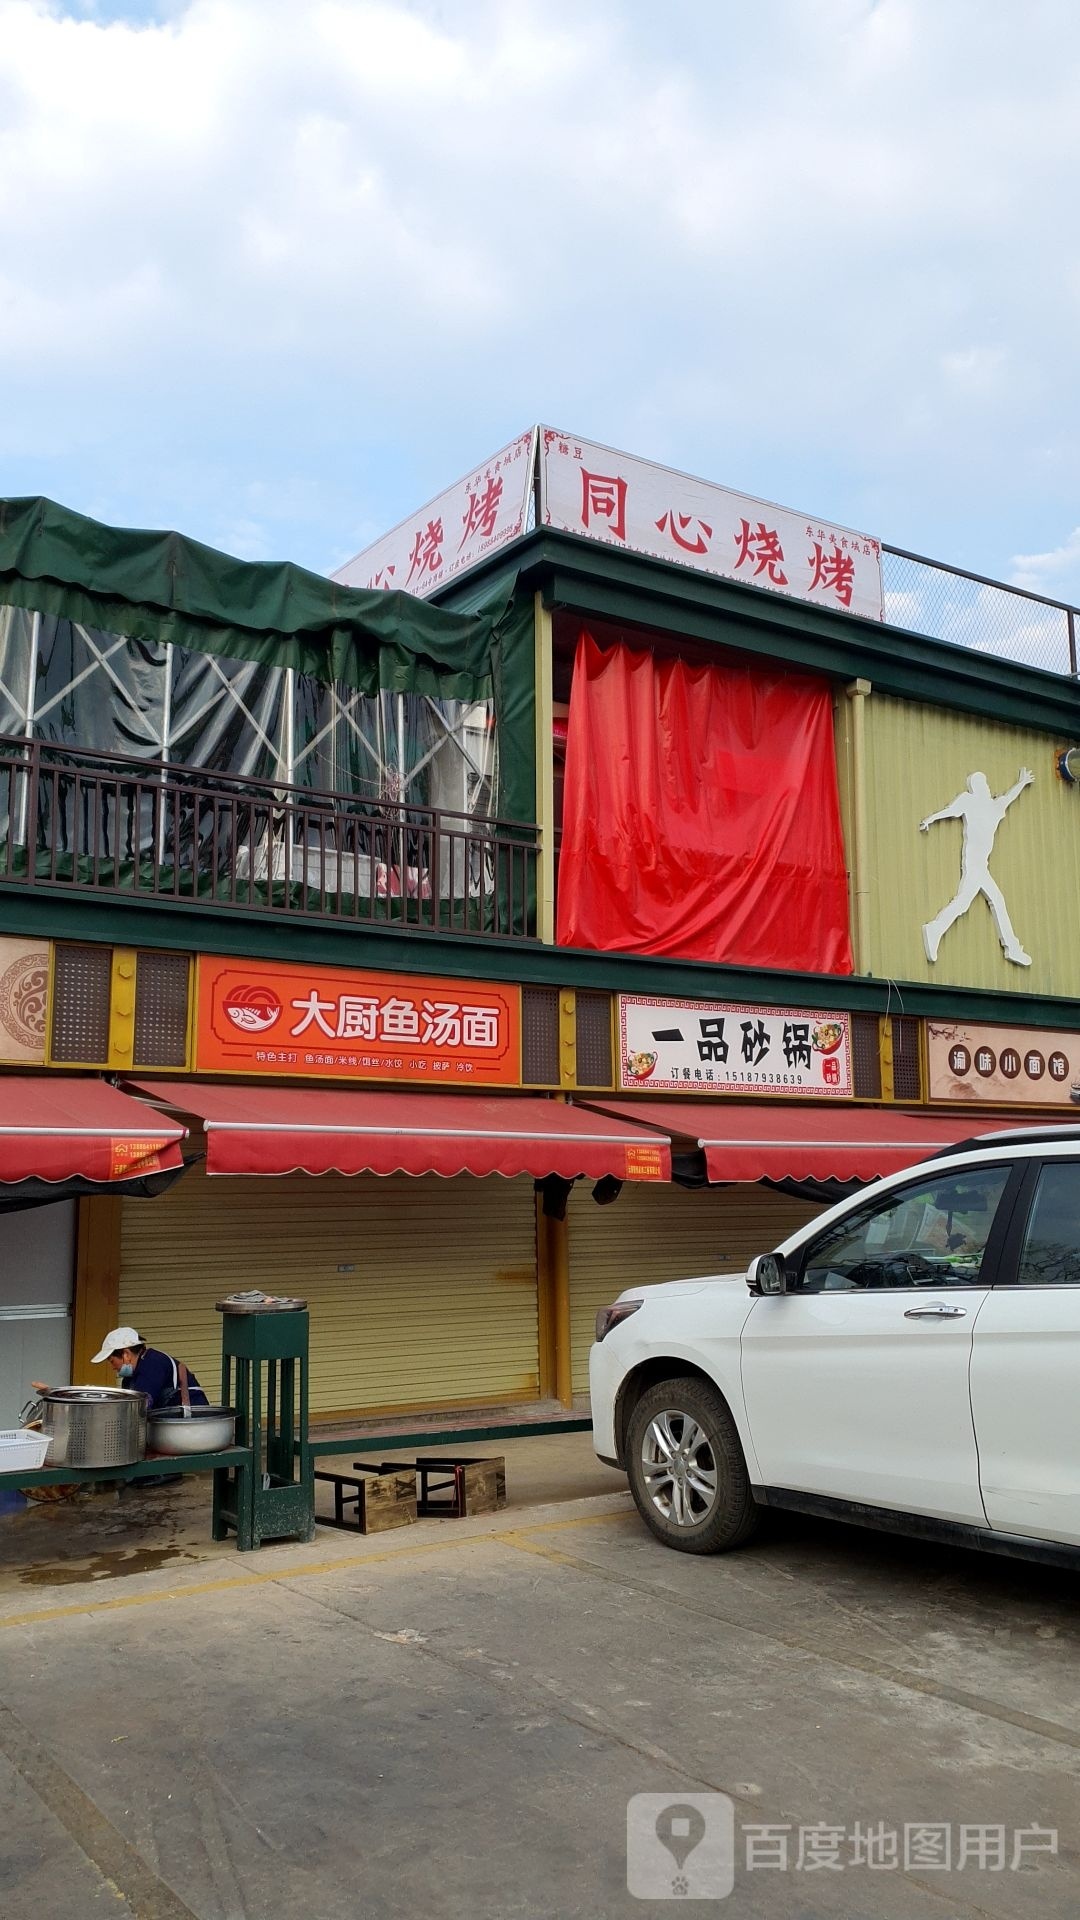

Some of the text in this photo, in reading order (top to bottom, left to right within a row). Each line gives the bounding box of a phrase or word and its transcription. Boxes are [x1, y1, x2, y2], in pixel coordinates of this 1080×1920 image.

[344, 477, 503, 591] 心烧烤
[580, 466, 856, 607] 同心烧烤
[805, 524, 871, 556] 东华美食城店
[290, 989, 501, 1048] 大厨鱼汤面
[652, 1018, 811, 1070] 一品砂锅
[256, 1050, 298, 1063] 特色主打
[409, 1060, 427, 1070] 小吃
[456, 1062, 474, 1073] 冷饮
[953, 1051, 1065, 1076] 渝味小面馆
